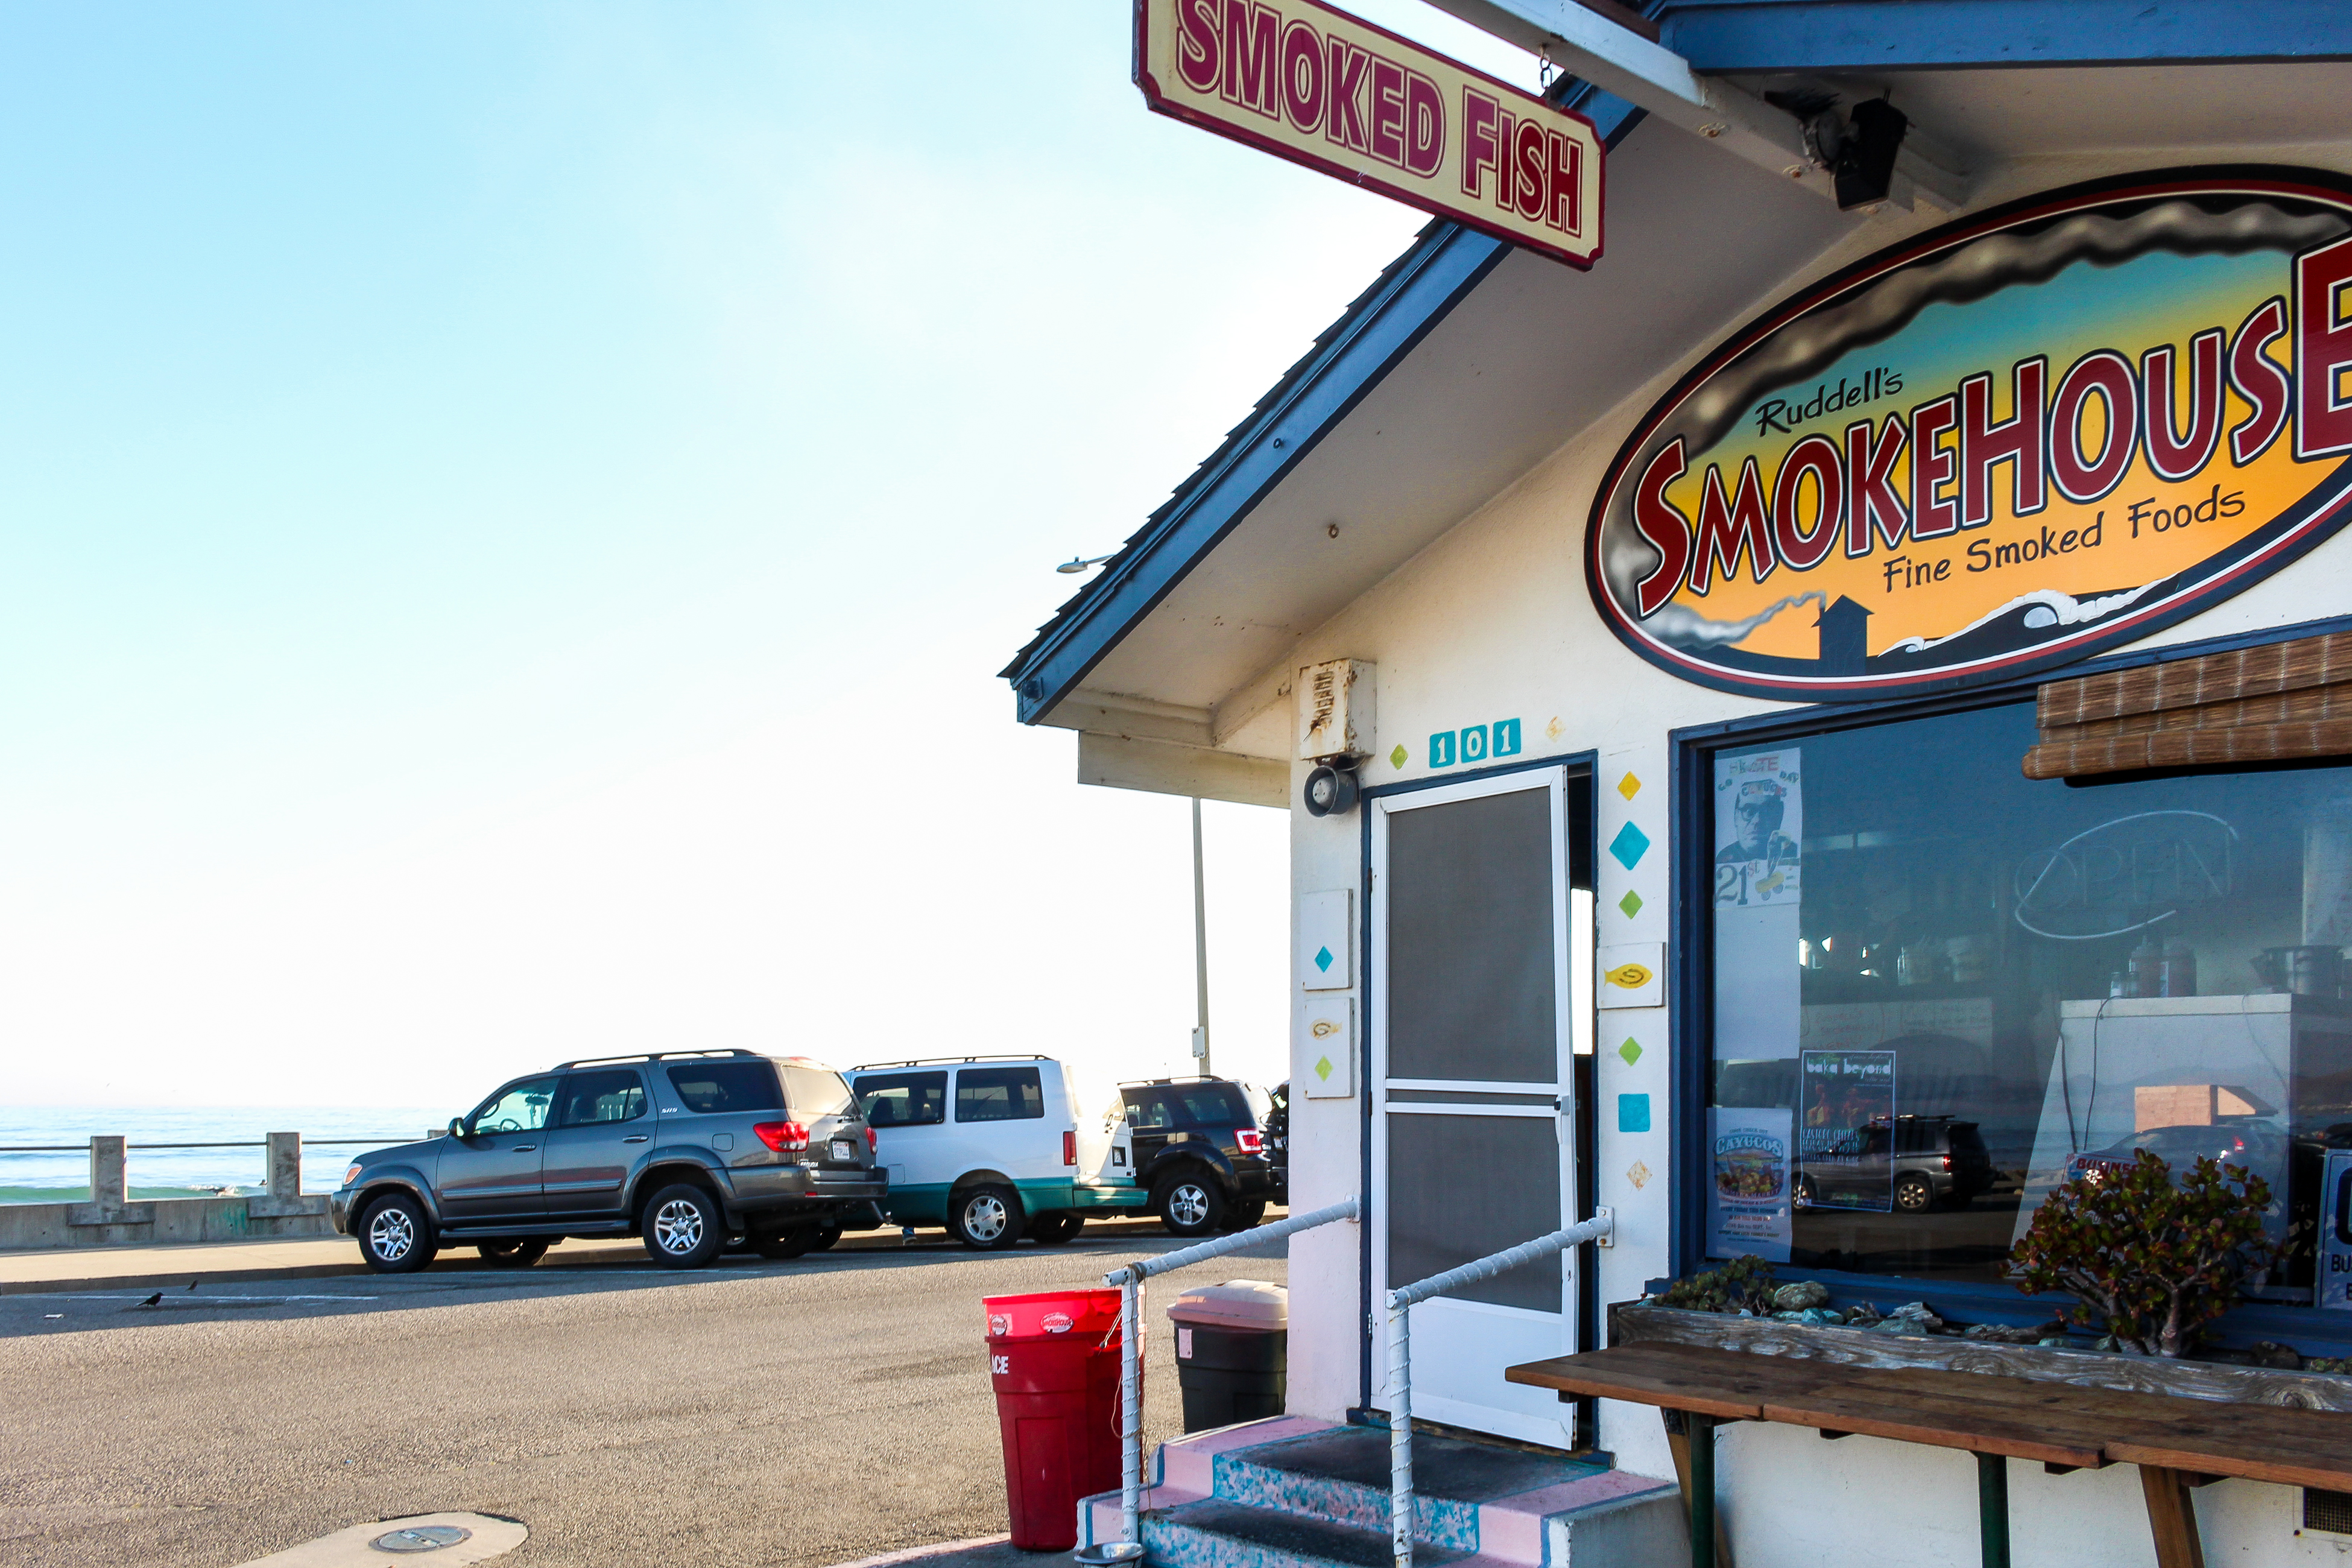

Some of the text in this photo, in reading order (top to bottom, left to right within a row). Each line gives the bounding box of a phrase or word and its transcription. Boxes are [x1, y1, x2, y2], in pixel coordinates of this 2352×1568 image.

[1177, 0, 1584, 238] SMOKED FISH
[1632, 231, 2352, 619] SMOKEHOUSE
[1754, 367, 1903, 437] Ruddell's
[1883, 484, 2246, 593] Fine Smoked Foods
[1436, 724, 1512, 763] 101
[1844, 1058, 1892, 1079] beyond
[1716, 1136, 1783, 1157] CAYUCOS
